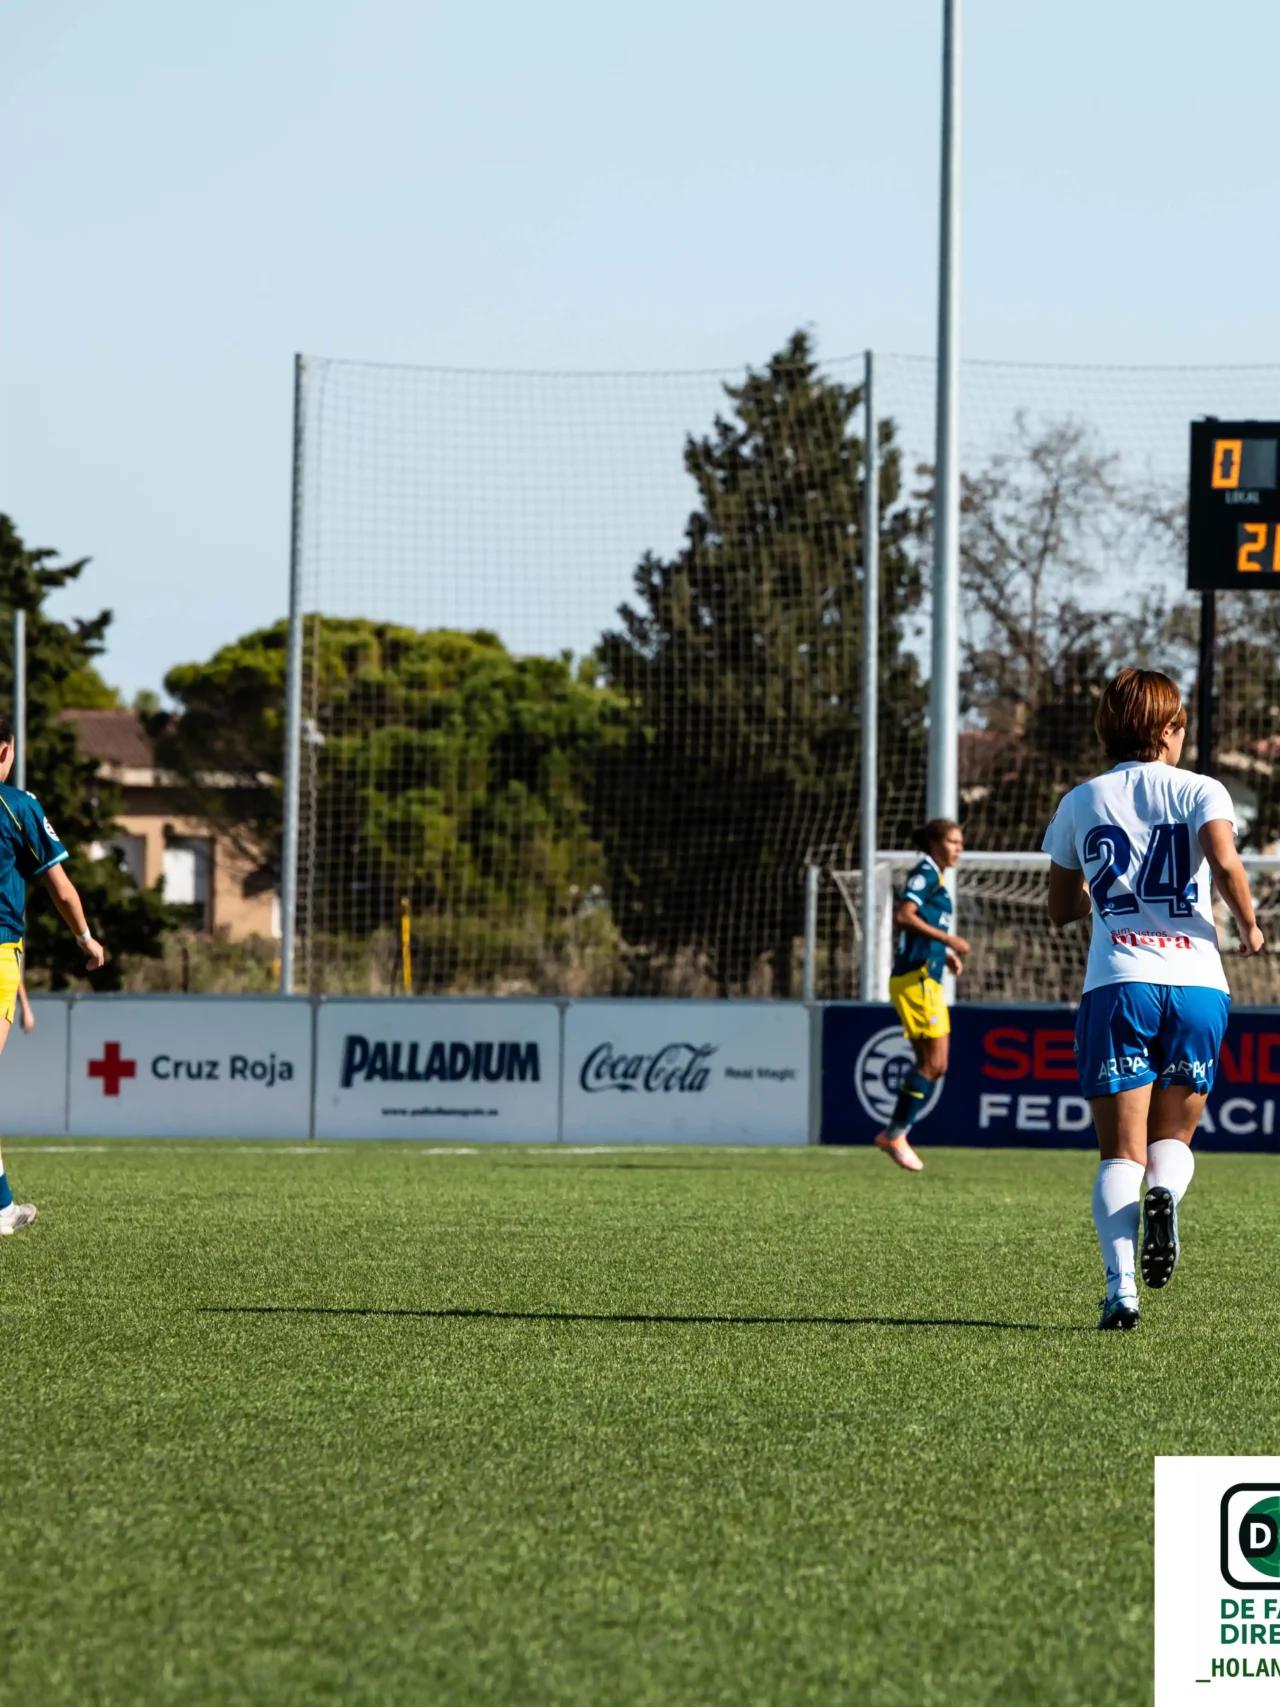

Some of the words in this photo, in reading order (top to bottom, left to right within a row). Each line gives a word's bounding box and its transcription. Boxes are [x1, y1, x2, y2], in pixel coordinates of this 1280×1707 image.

[1211, 439, 1243, 489] 0
[1083, 823, 1199, 918] 24
[1111, 932, 1192, 950] mera
[151, 1054, 220, 1080] Cruz
[229, 1052, 294, 1087] Roja
[341, 1034, 540, 1088] PALLADIUM
[1097, 1056, 1148, 1080] ARPA
